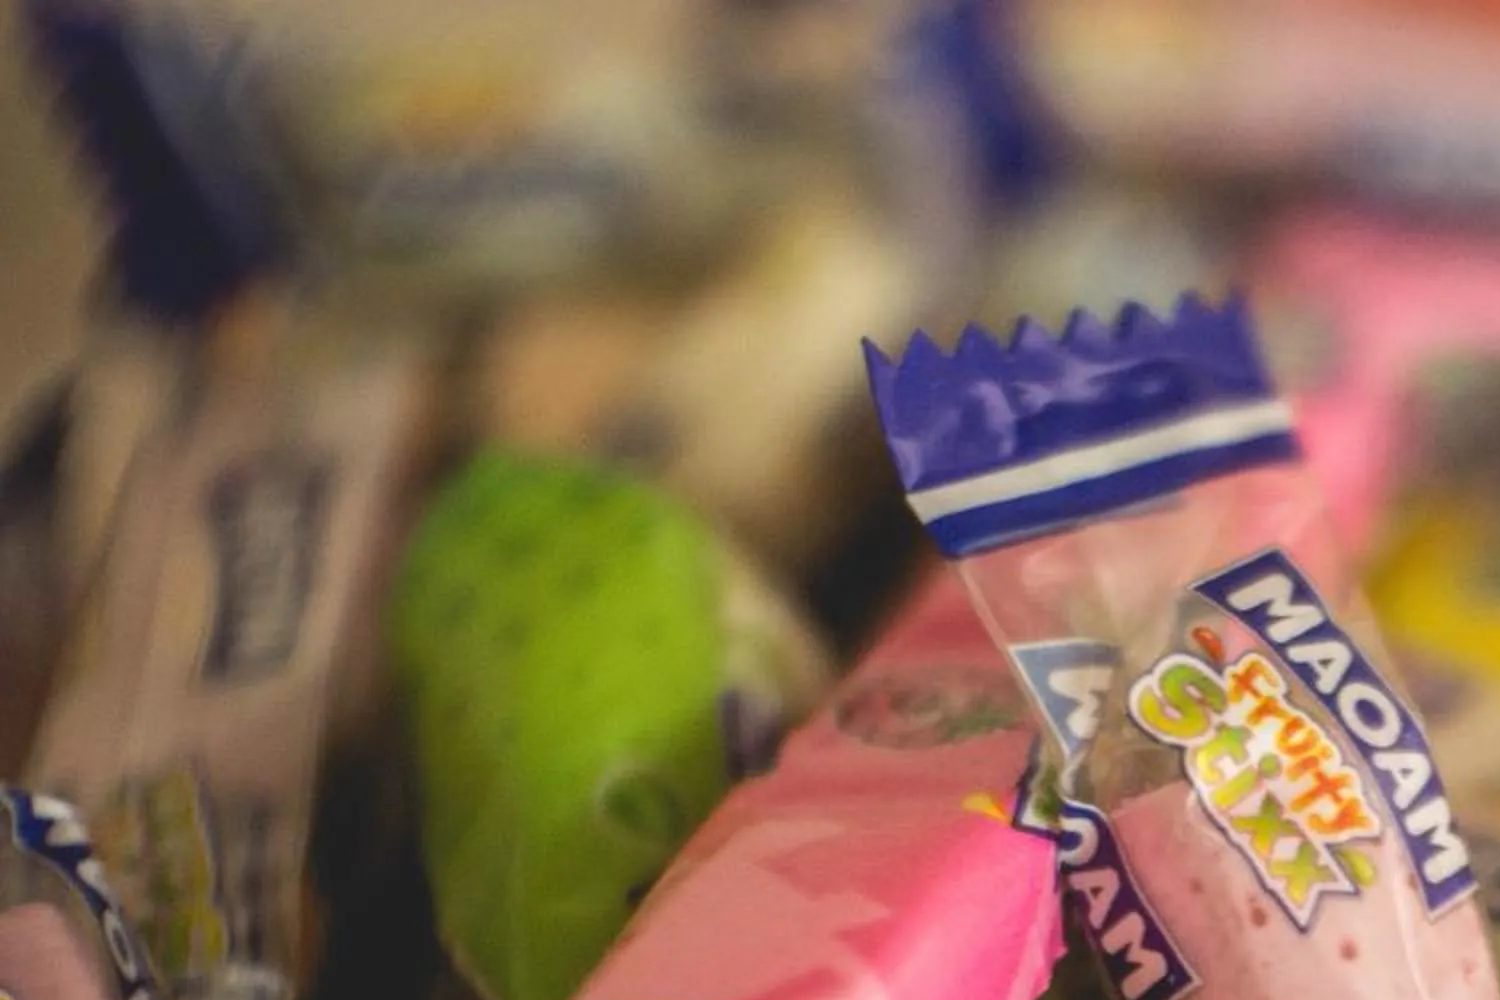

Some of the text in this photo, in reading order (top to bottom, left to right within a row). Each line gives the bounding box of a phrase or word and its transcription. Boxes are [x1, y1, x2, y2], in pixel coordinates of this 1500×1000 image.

[1139, 663, 1332, 904] Stixx
[1226, 660, 1375, 833] fruity
[1227, 571, 1468, 884] MAOAM
